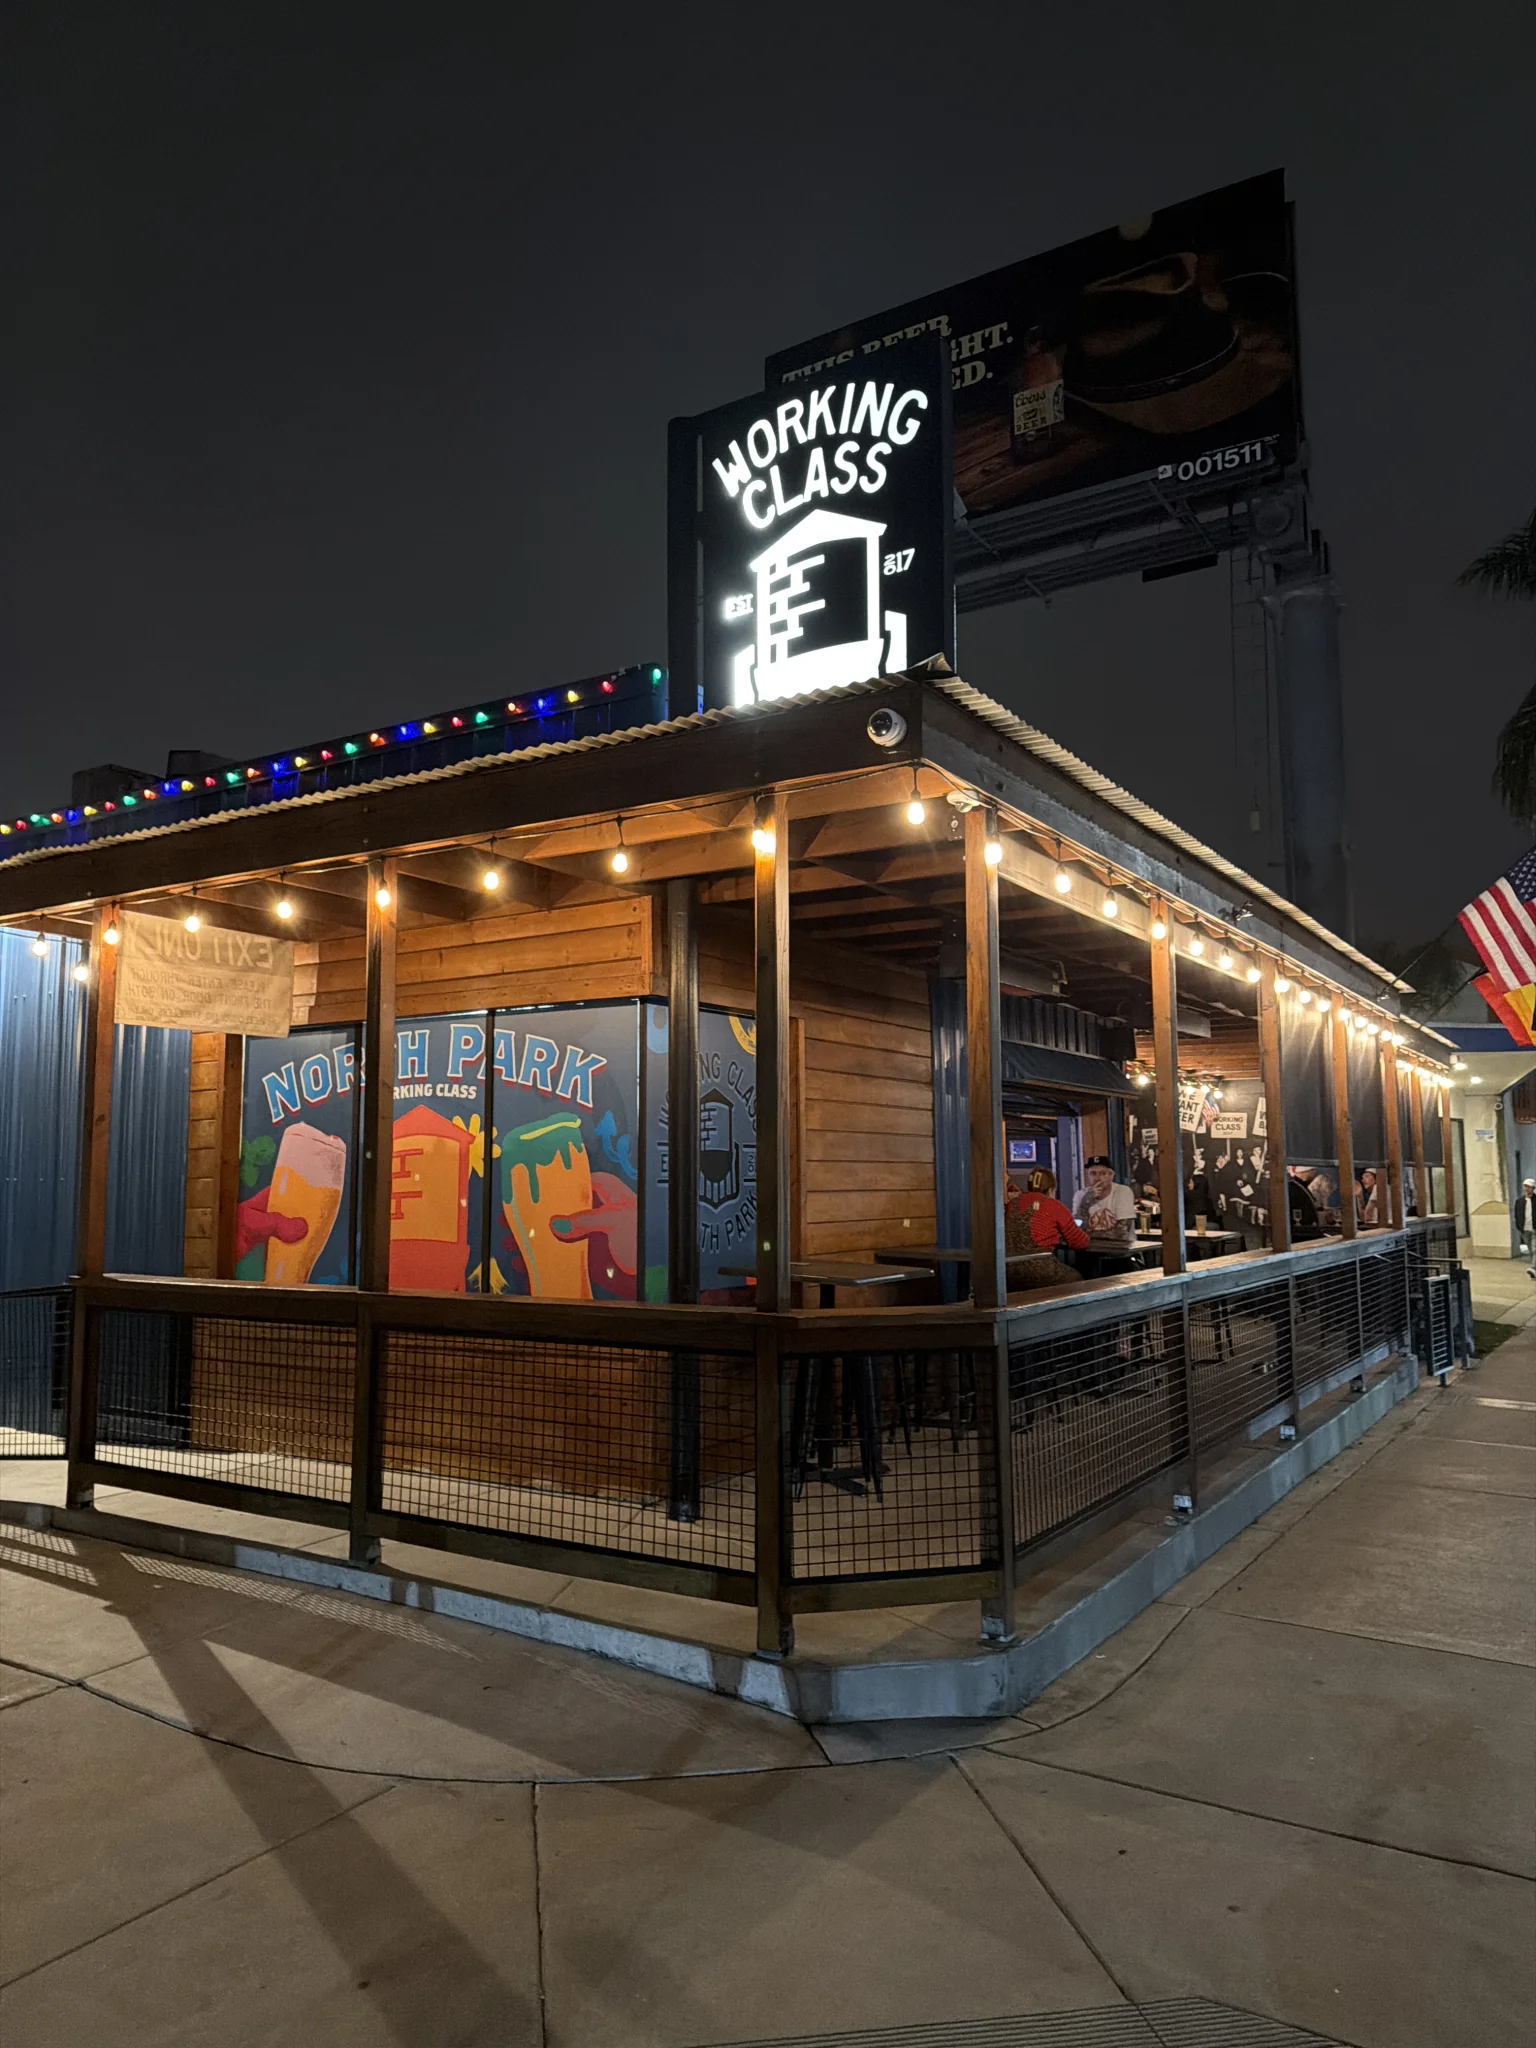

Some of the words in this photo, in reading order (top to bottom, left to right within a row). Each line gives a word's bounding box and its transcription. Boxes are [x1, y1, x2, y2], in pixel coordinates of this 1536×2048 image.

[951, 322, 1013, 361] HT.
[712, 381, 929, 497] WORKING
[1177, 442, 1262, 481] 001511
[742, 440, 892, 529] CLASS
[262, 1030, 430, 1124] NORH
[447, 1024, 608, 1110] PARK
[393, 1084, 433, 1100] RKING
[435, 1083, 477, 1100] CLASS
[1179, 1099, 1201, 1113] ANT
[1215, 1123, 1242, 1131] CLASS
